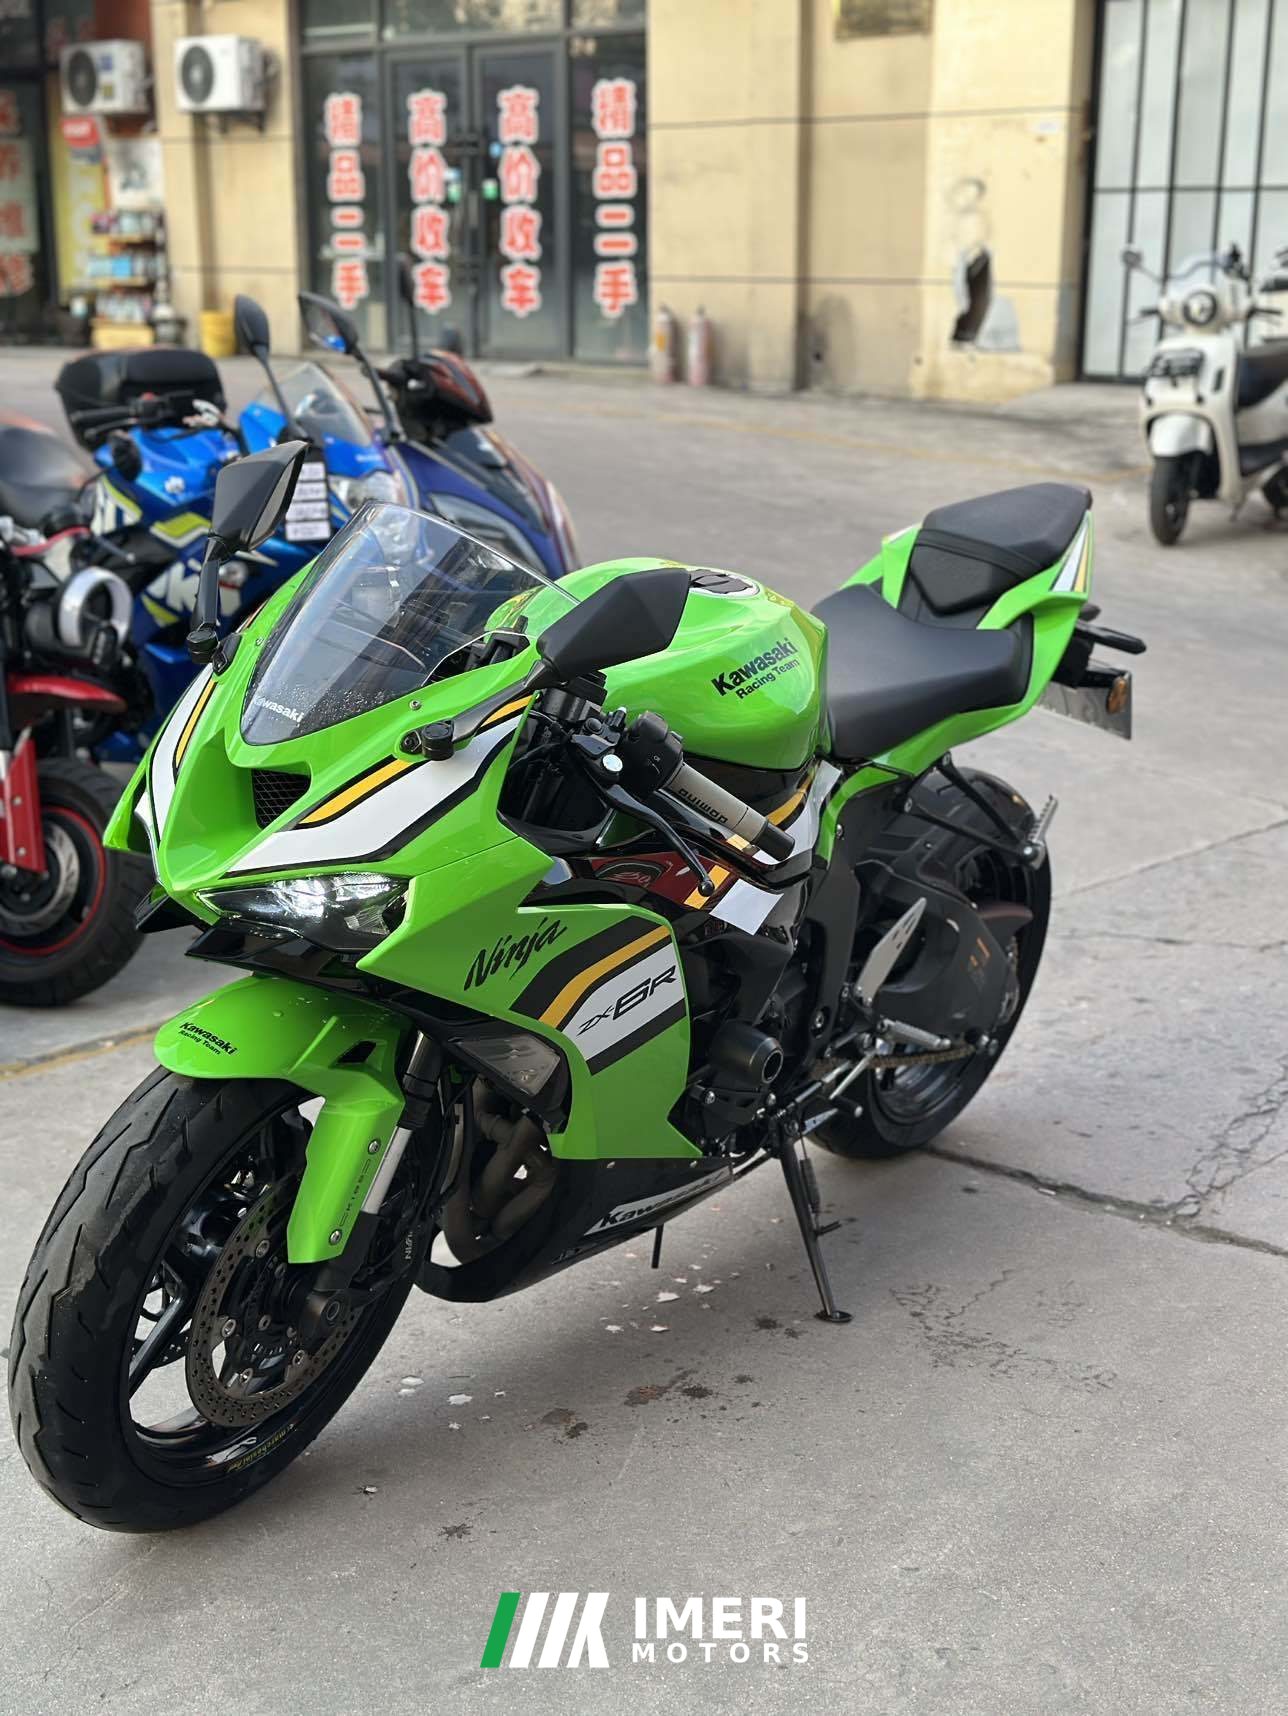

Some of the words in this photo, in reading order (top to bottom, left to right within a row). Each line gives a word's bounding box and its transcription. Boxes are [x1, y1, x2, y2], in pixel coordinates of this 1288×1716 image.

[326, 94, 369, 309] 精品二手
[408, 90, 450, 314] 高价收车
[497, 86, 541, 316] 高价收车
[593, 79, 638, 316] 精品二手
[711, 637, 798, 696] Kawasaki
[735, 672, 776, 699] Racing
[771, 659, 800, 675] Team
[464, 917, 567, 991] Ninja
[576, 966, 676, 1036] ZX-6R
[179, 1022, 238, 1055] Kawasaki
[202, 1040, 221, 1055] Team
